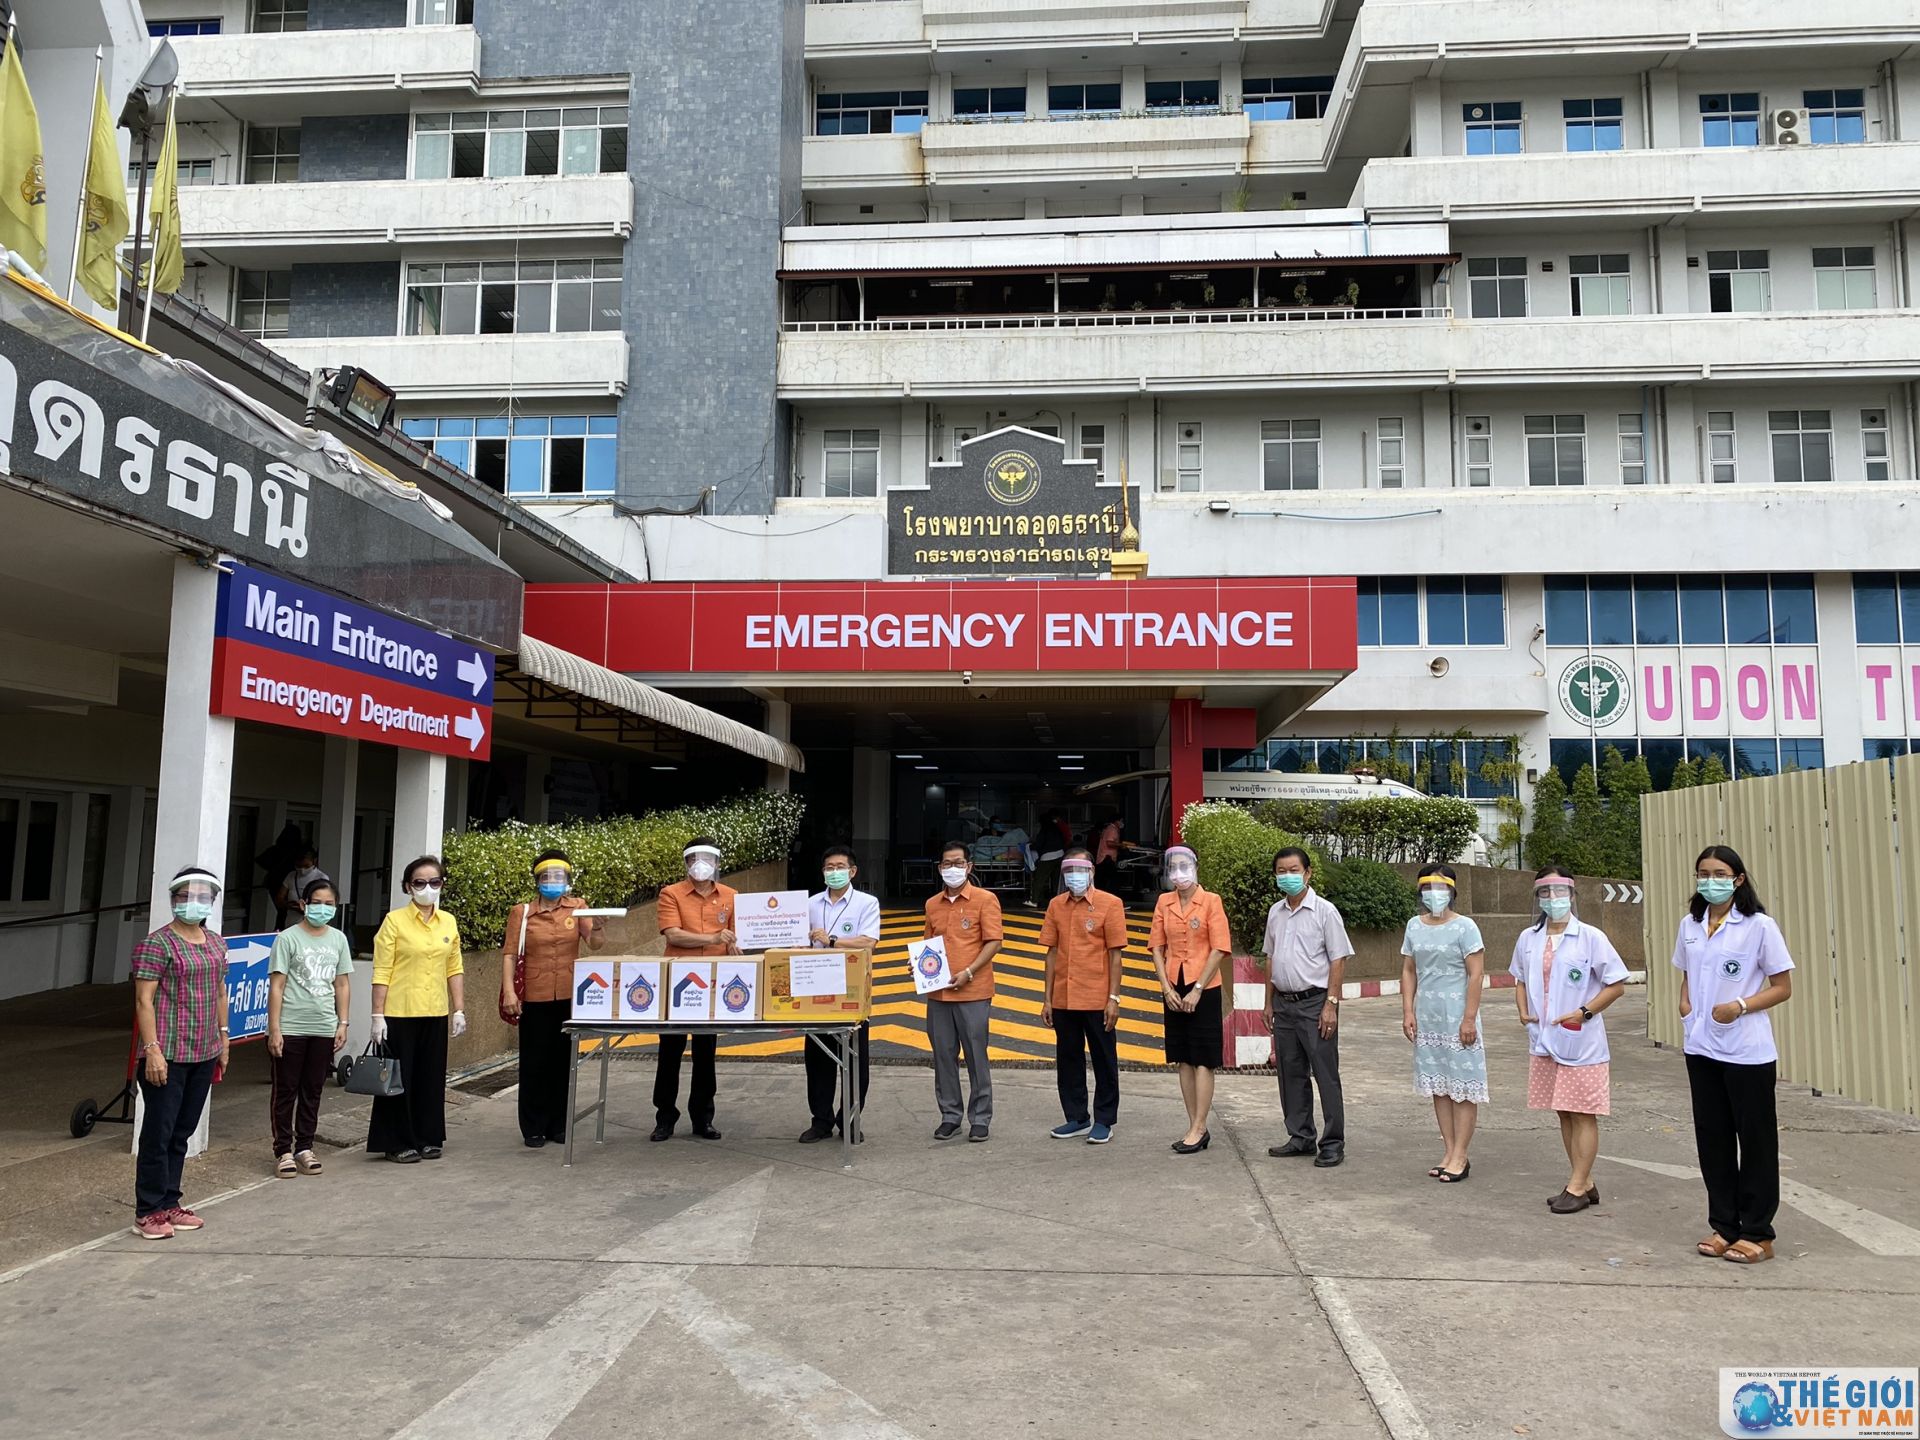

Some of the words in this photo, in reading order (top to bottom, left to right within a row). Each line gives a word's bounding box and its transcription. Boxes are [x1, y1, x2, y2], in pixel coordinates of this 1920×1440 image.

[903, 503, 1119, 547] โรงพยาบาลอุดรธานี
[914, 546, 1112, 568] กระทรวงสาธารณสุข
[245, 584, 320, 647] Main
[332, 612, 438, 680] Entrance
[745, 612, 1025, 649] EMERGENCY
[1046, 611, 1293, 647] ENTRANCE
[240, 666, 352, 724] Emergency
[360, 694, 449, 739] Department
[1563, 697, 1582, 719] MINISTRY
[1594, 715, 1614, 725] PUBLIC
[1613, 698, 1627, 717] HEALTH
[1644, 664, 1817, 722] UDON
